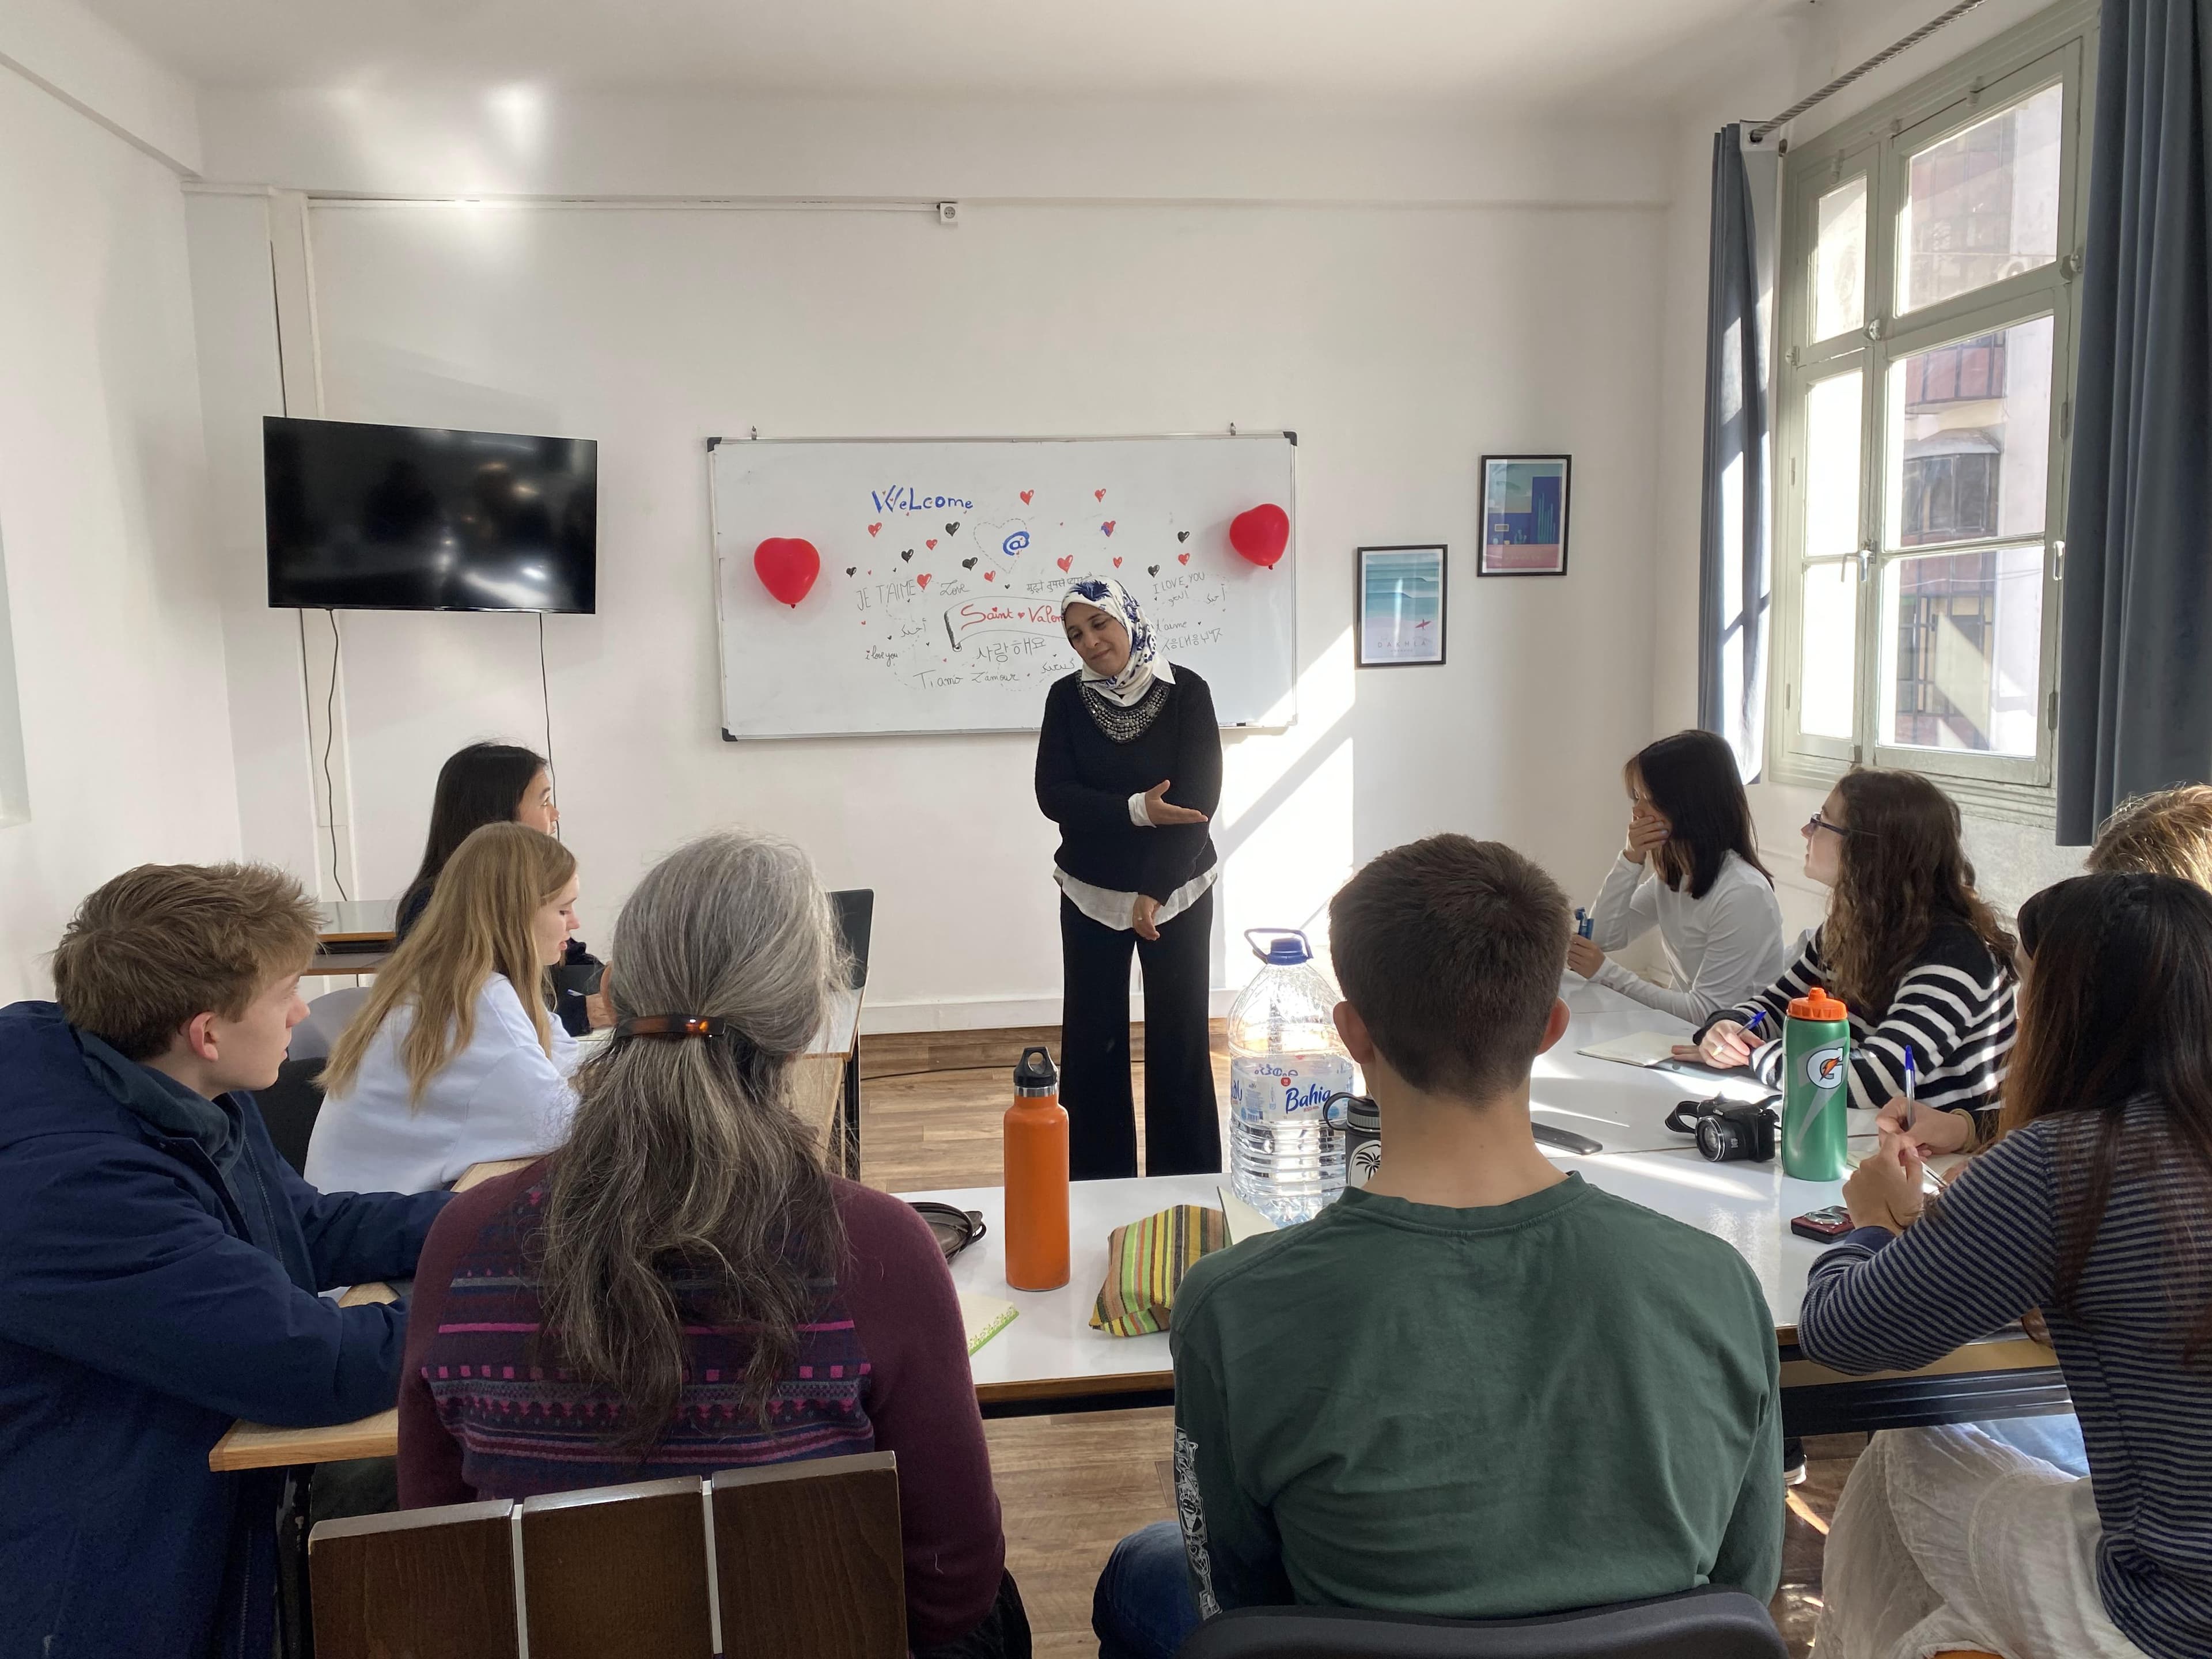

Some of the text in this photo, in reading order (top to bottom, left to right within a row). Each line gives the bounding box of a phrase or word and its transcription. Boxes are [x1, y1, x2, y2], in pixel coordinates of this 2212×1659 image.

[856, 579, 916, 611] JE T'AIME
[1153, 571, 1205, 594] I LOVE YOU
[961, 603, 1014, 630] Saint
[871, 645, 884, 660] love
[885, 651, 899, 667] you
[1286, 1083, 1331, 1114] Bahia
